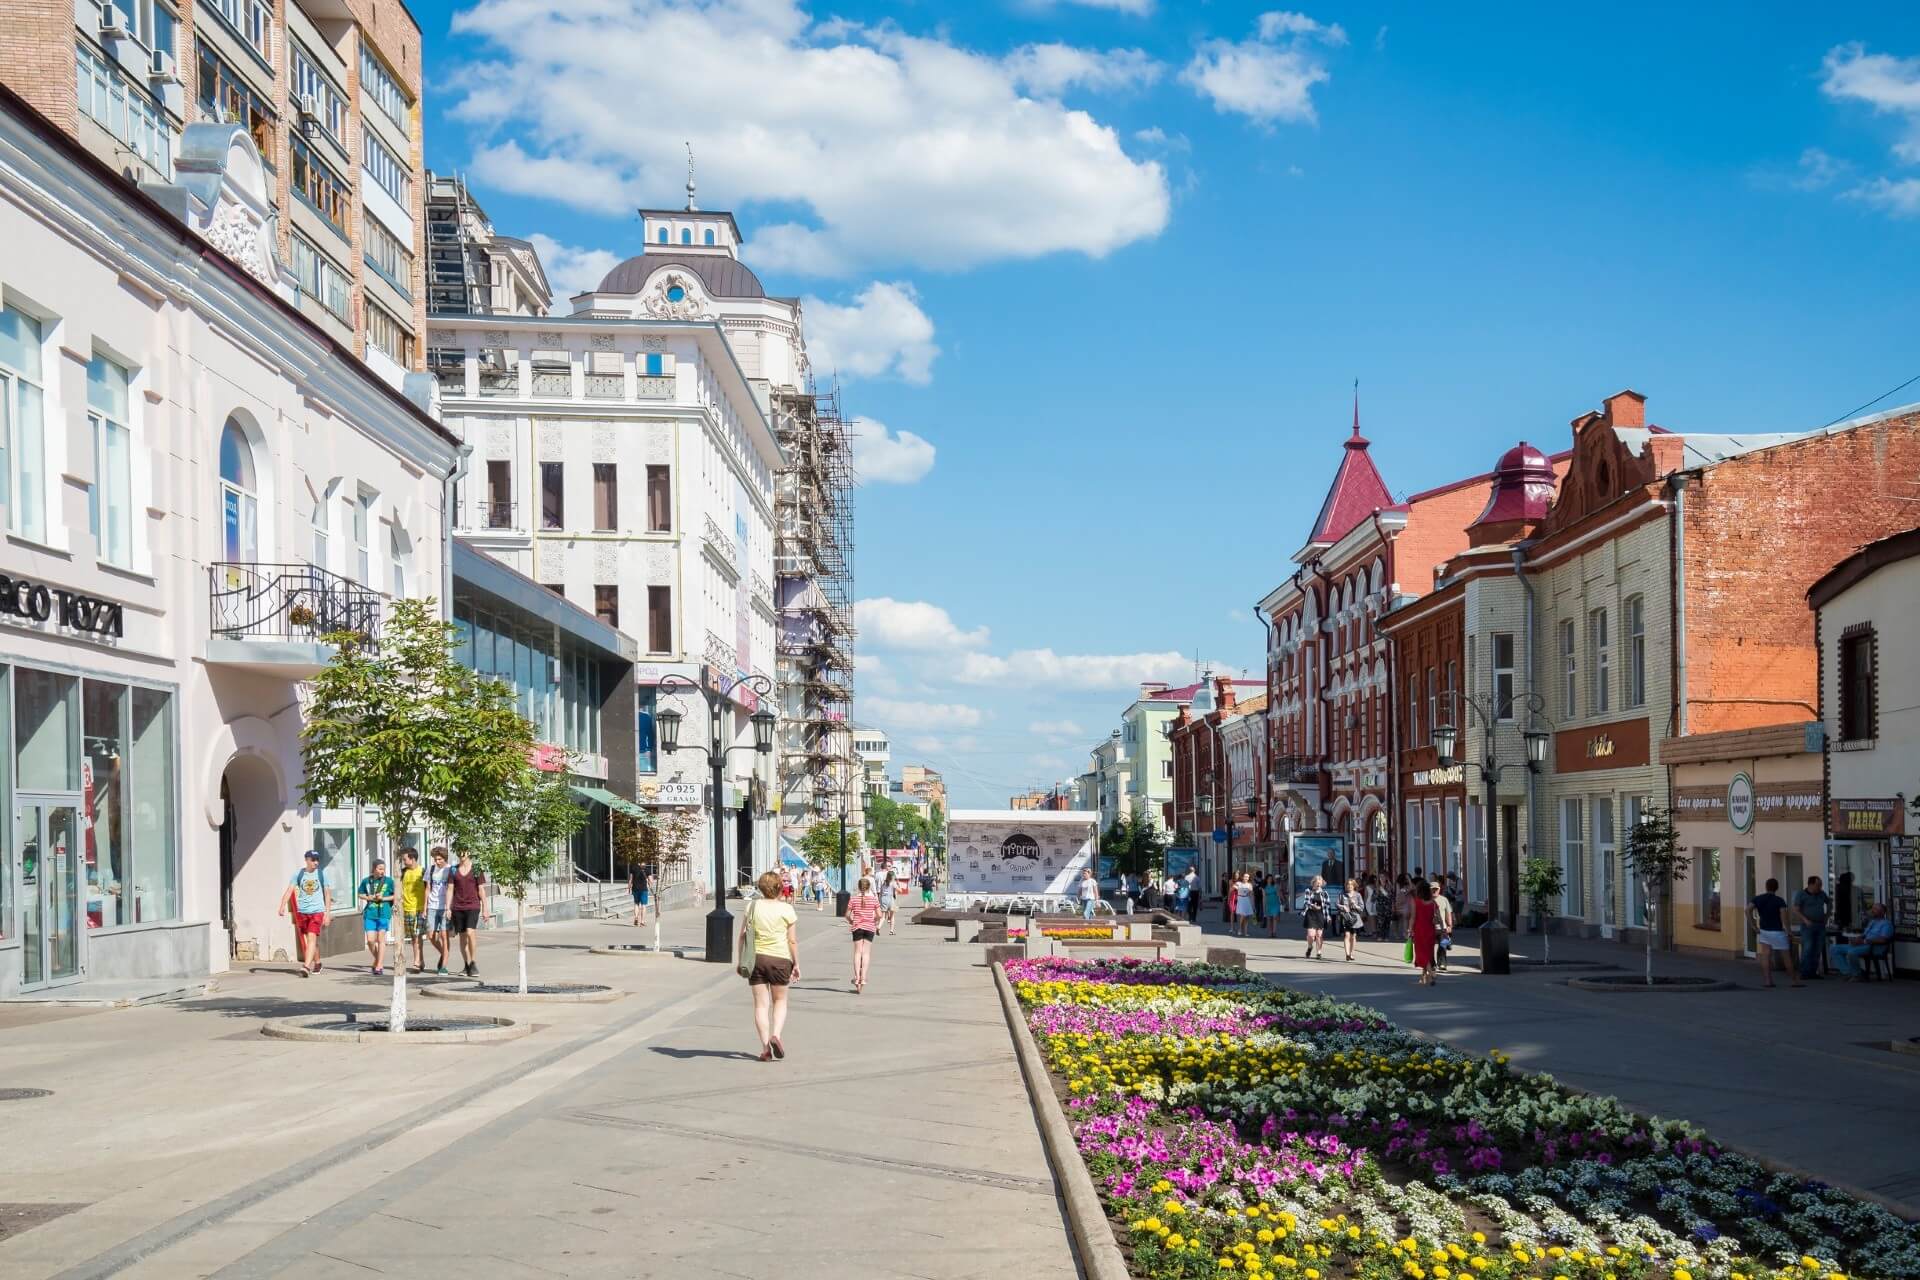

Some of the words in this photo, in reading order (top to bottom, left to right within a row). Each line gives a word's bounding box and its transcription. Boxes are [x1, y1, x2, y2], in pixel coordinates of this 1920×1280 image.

[52, 589, 123, 638] TOZZI
[676, 785, 695, 794] 925
[1847, 811, 1883, 831] ЛАВКА
